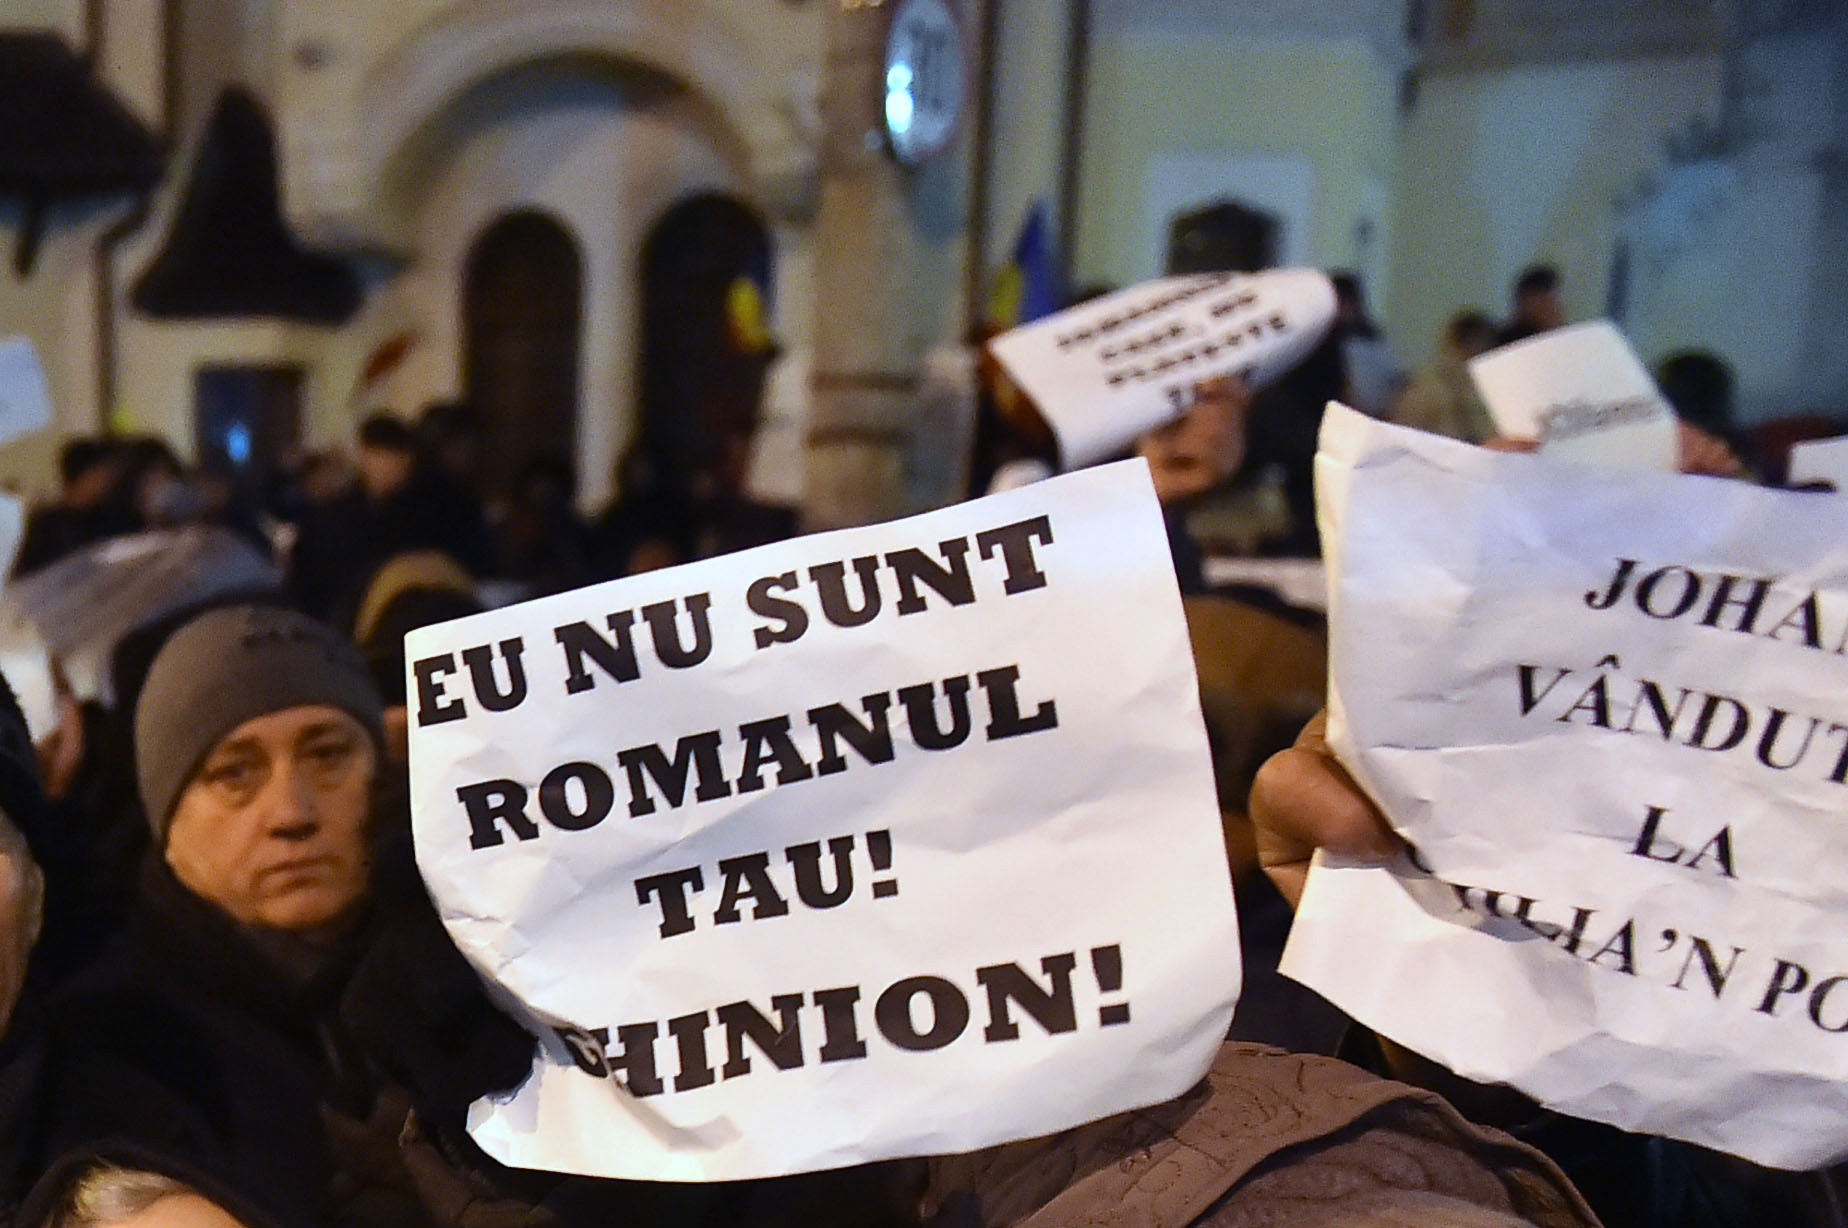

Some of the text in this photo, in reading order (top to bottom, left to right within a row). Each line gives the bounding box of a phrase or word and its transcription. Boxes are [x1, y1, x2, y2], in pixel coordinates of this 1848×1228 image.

[412, 513, 1054, 728] EU NU SUNT
[456, 664, 1059, 850] ROMANUL
[633, 829, 900, 939] TAU!
[1626, 805, 1739, 880] LA
